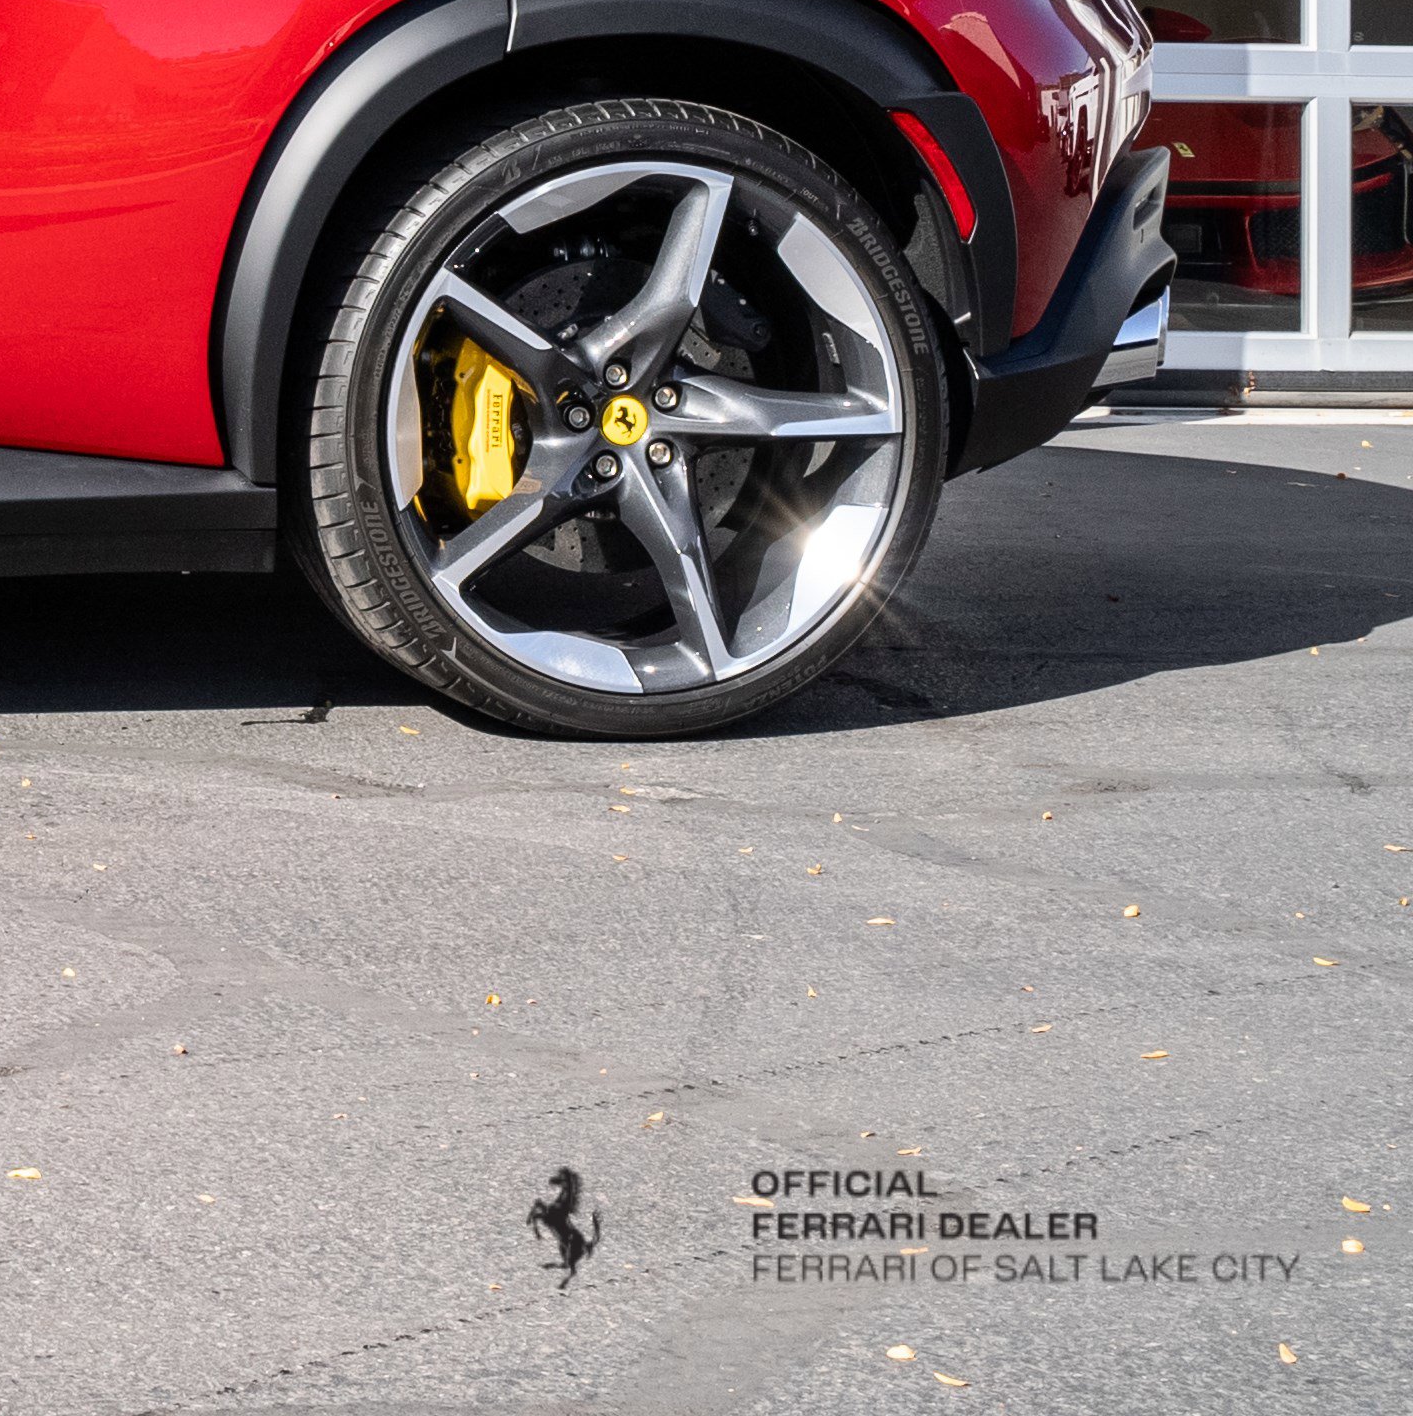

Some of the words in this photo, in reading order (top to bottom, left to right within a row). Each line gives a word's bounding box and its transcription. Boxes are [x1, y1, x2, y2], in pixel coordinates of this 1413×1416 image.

[846, 216, 930, 356] BRIDGESTONE
[492, 394, 503, 447] Ferrari
[360, 500, 448, 640] BRIDGESTONE
